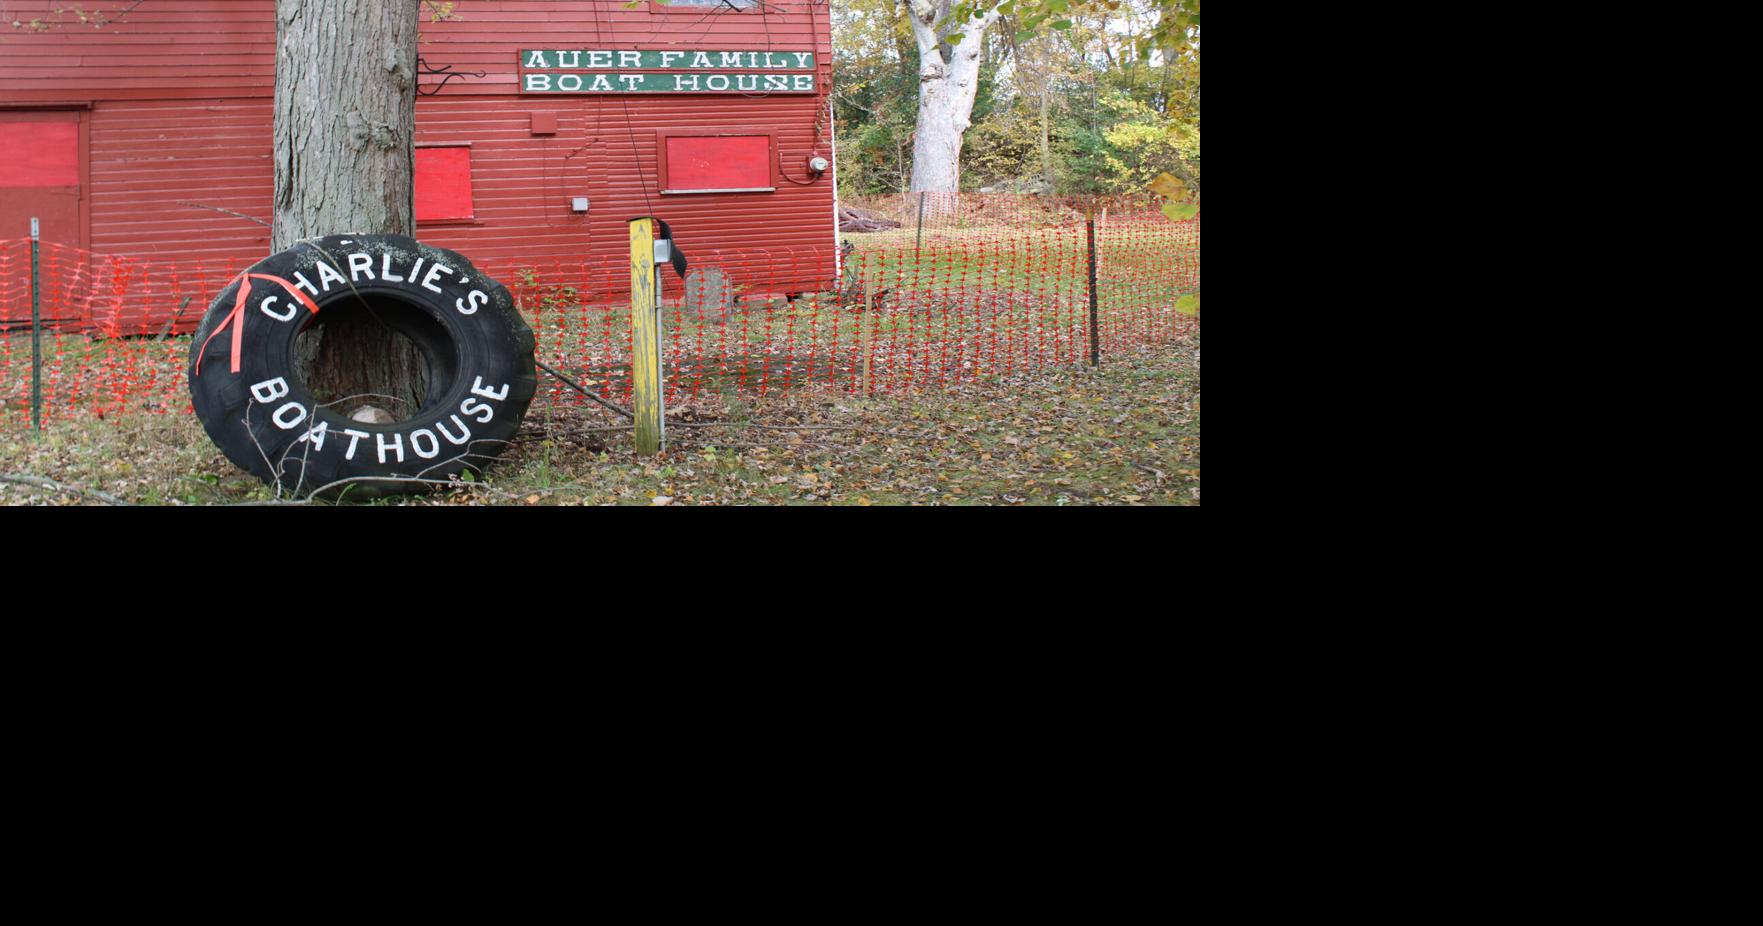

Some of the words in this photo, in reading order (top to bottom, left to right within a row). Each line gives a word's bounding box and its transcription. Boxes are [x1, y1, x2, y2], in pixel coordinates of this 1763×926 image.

[524, 50, 642, 69] AUER
[659, 51, 813, 69] FAMILY
[525, 74, 645, 91] BOAT
[672, 74, 814, 91] HOUSE
[260, 252, 489, 323] CHARLIE'S
[250, 375, 510, 464] BOATHOUSE
